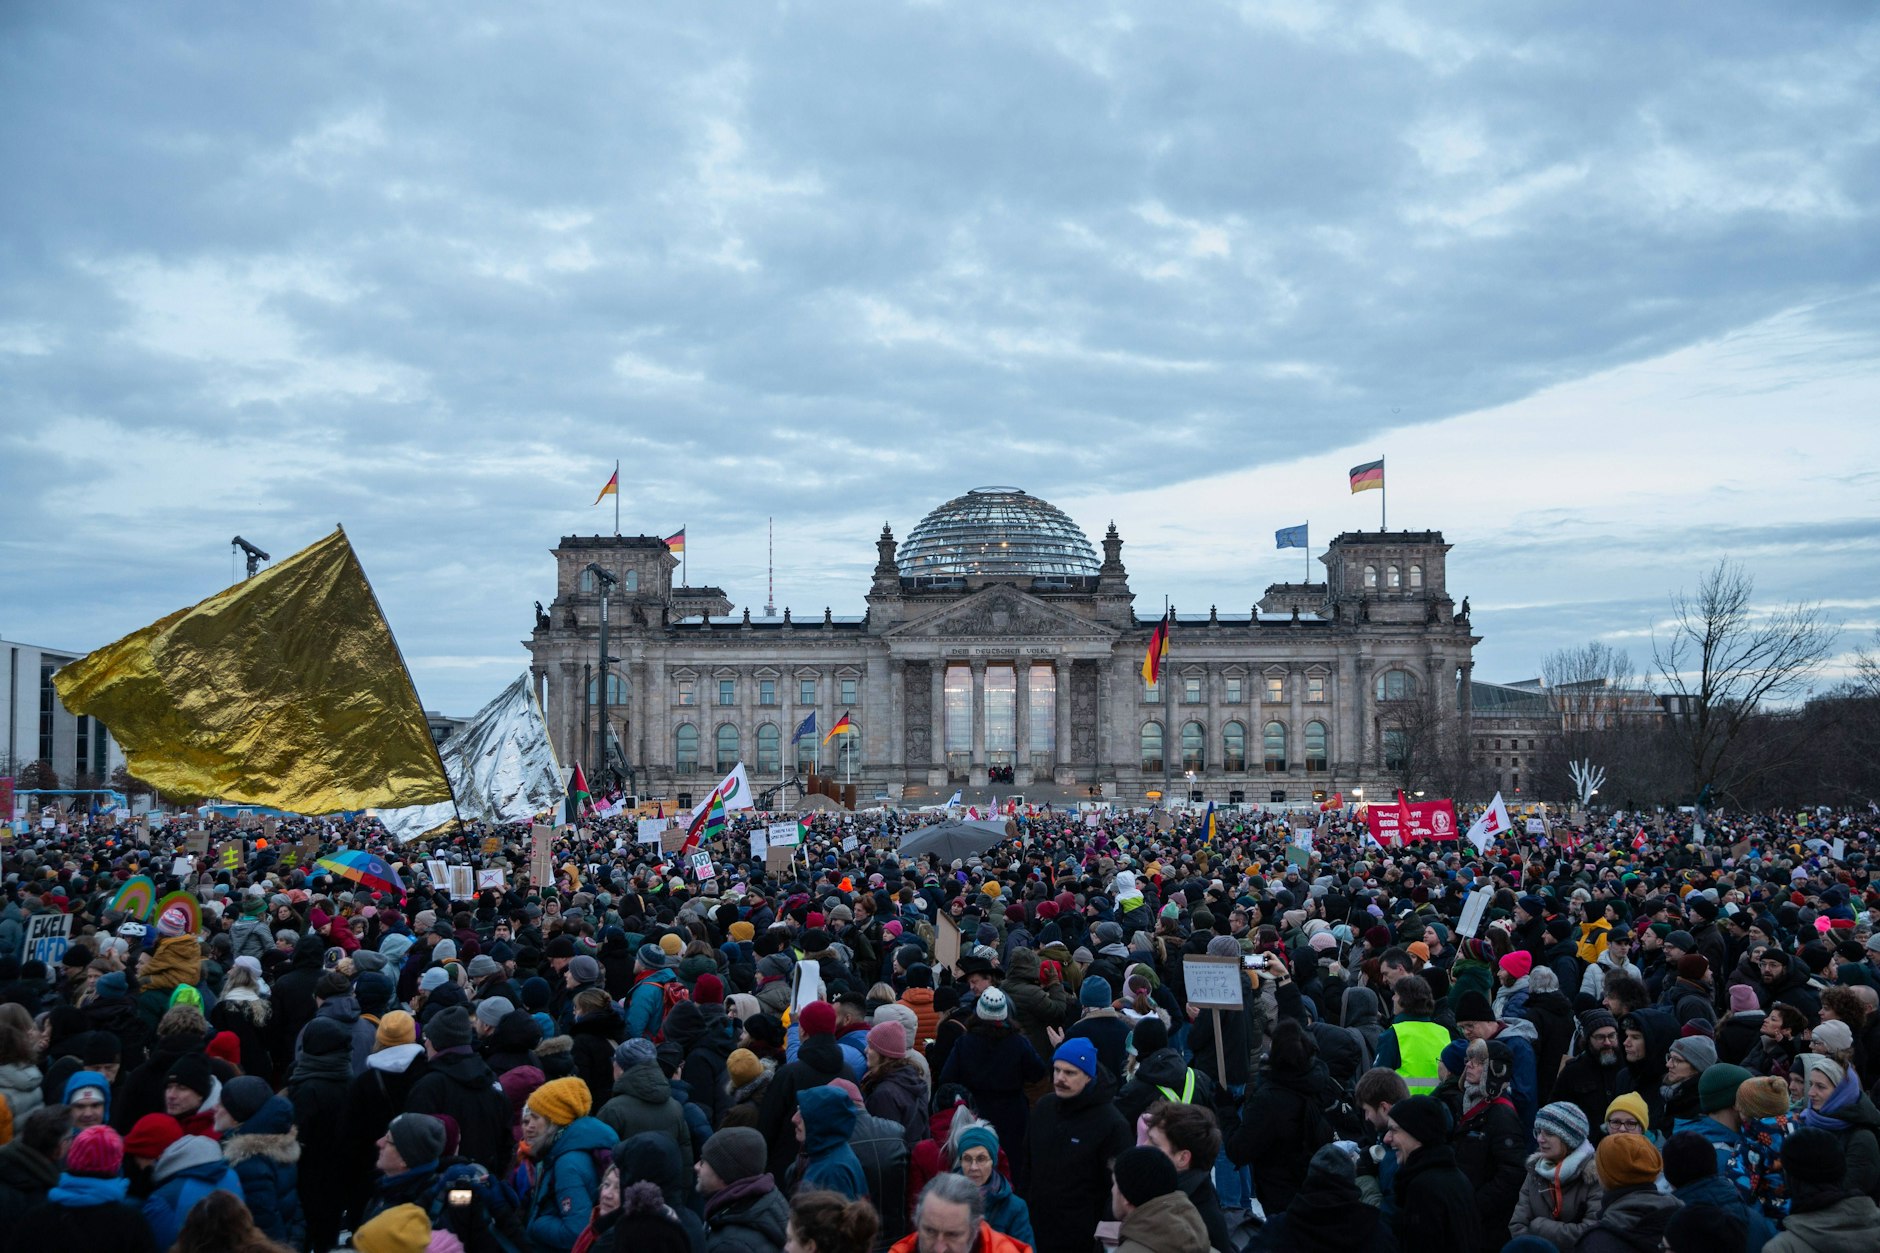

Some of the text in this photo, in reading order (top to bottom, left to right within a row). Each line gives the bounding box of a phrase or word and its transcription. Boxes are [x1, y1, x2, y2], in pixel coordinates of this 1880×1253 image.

[694, 853, 710, 867] AFD
[32, 915, 67, 938] EKEL
[1196, 976, 1228, 987] FFP2
[1191, 988, 1237, 998] ANTIFA
